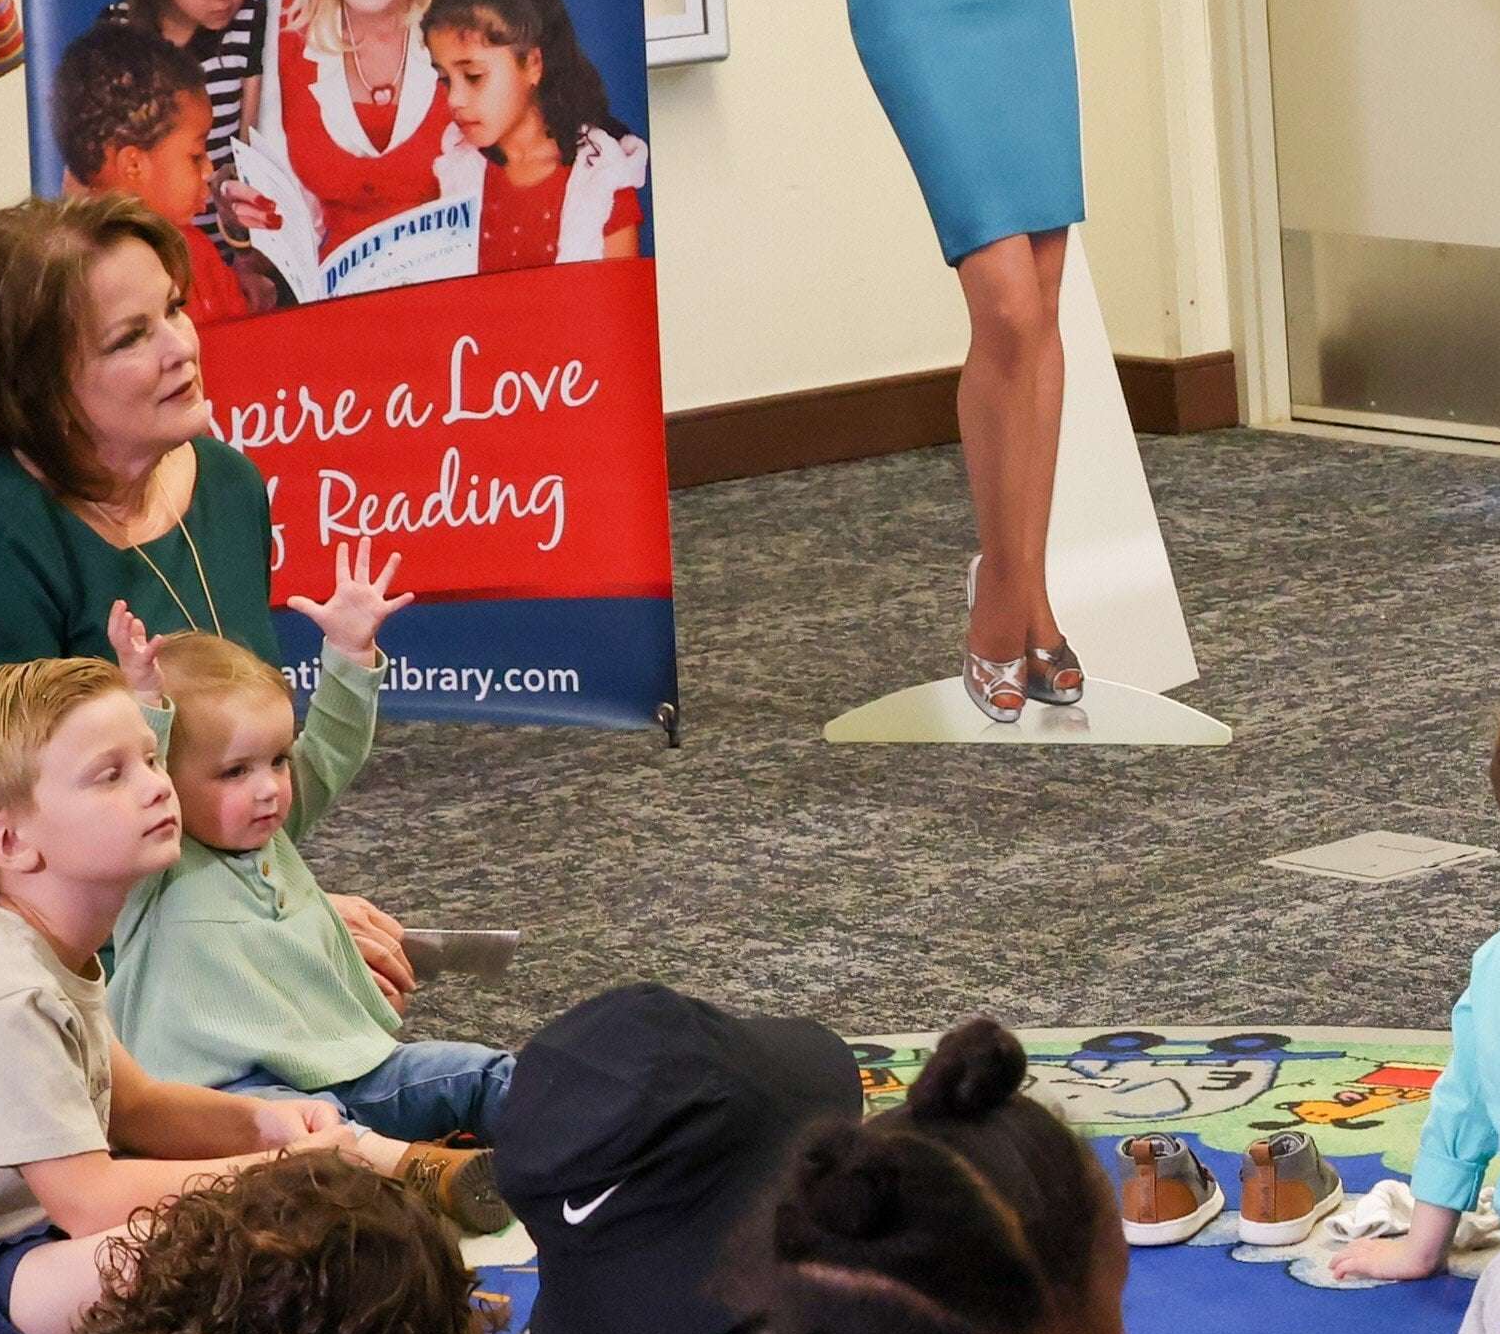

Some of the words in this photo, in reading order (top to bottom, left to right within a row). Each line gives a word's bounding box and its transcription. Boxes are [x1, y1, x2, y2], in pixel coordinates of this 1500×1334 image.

[325, 235, 382, 295] DOLLY
[393, 200, 472, 242] PARTON
[386, 382, 433, 428] a
[442, 334, 599, 425] Love
[318, 446, 567, 552] Reading
